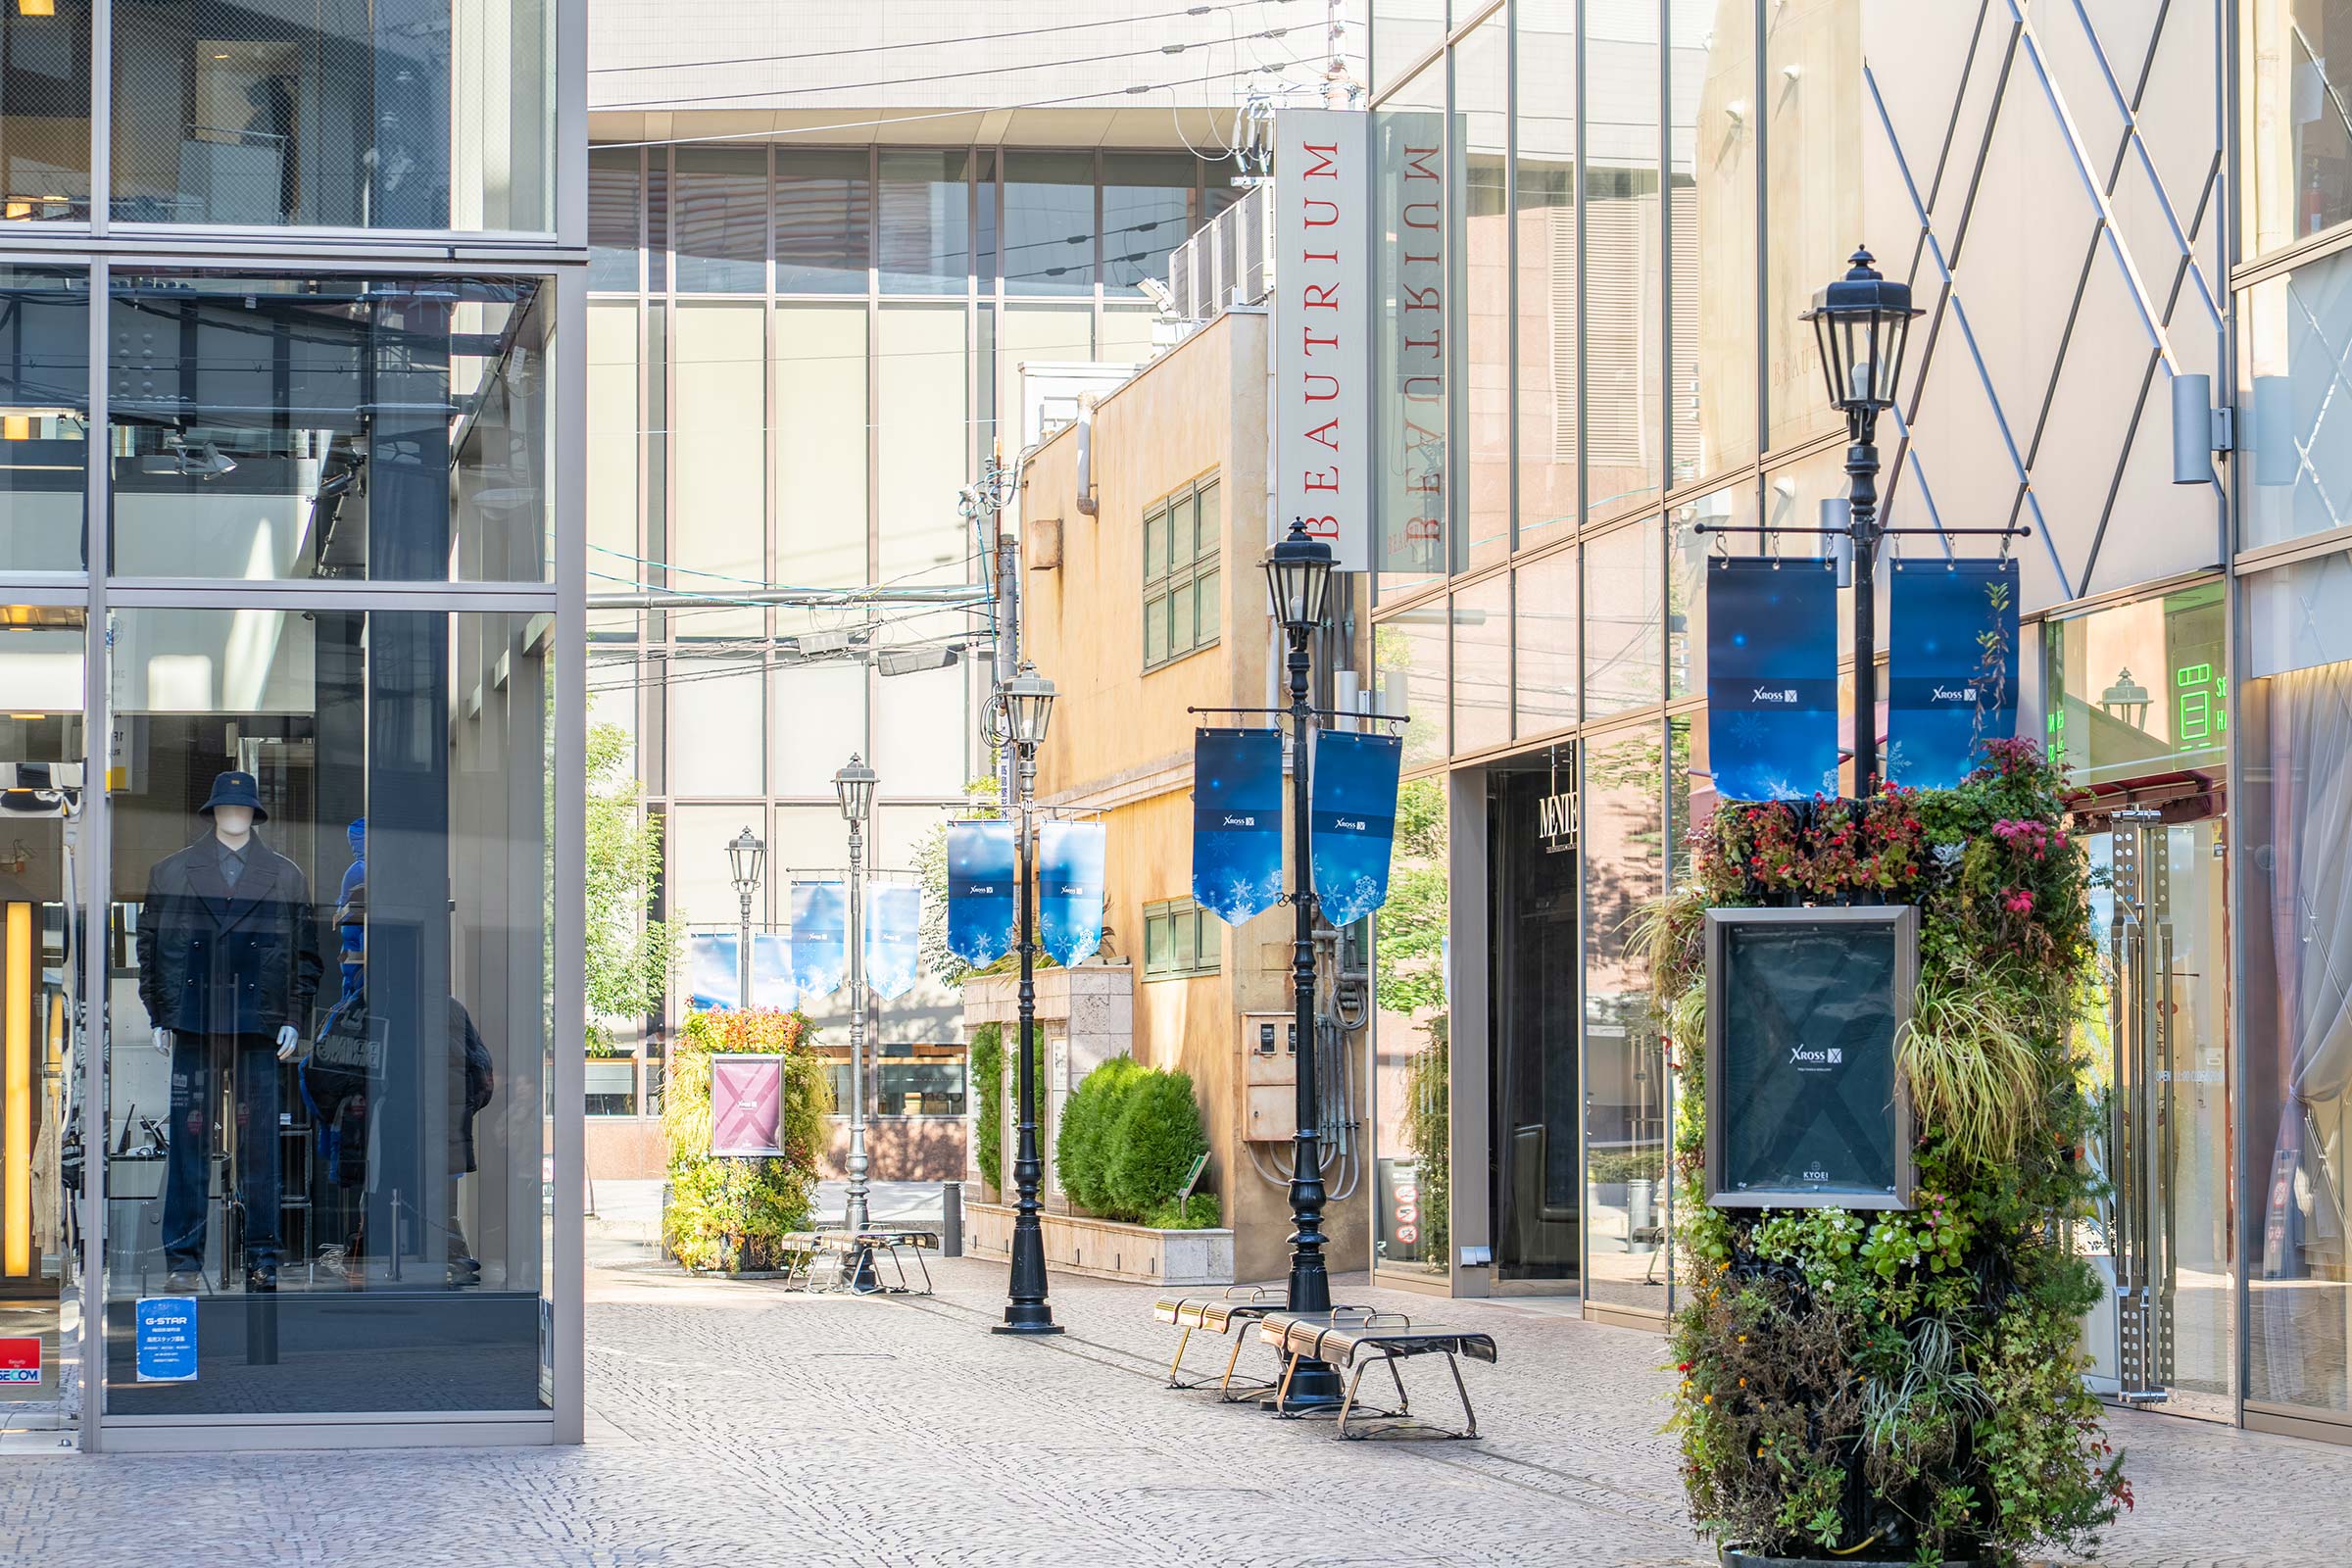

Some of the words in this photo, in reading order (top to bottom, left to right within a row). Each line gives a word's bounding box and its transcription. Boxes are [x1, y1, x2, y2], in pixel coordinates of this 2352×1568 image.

[1302, 140, 1340, 541] BEAUTRIUM
[1752, 686, 1784, 703] XROSS
[1931, 685, 1963, 702] XROSS
[1223, 814, 1246, 826] XROSS
[1335, 817, 1356, 829] XROSS
[1789, 1044, 1826, 1064] XROSS
